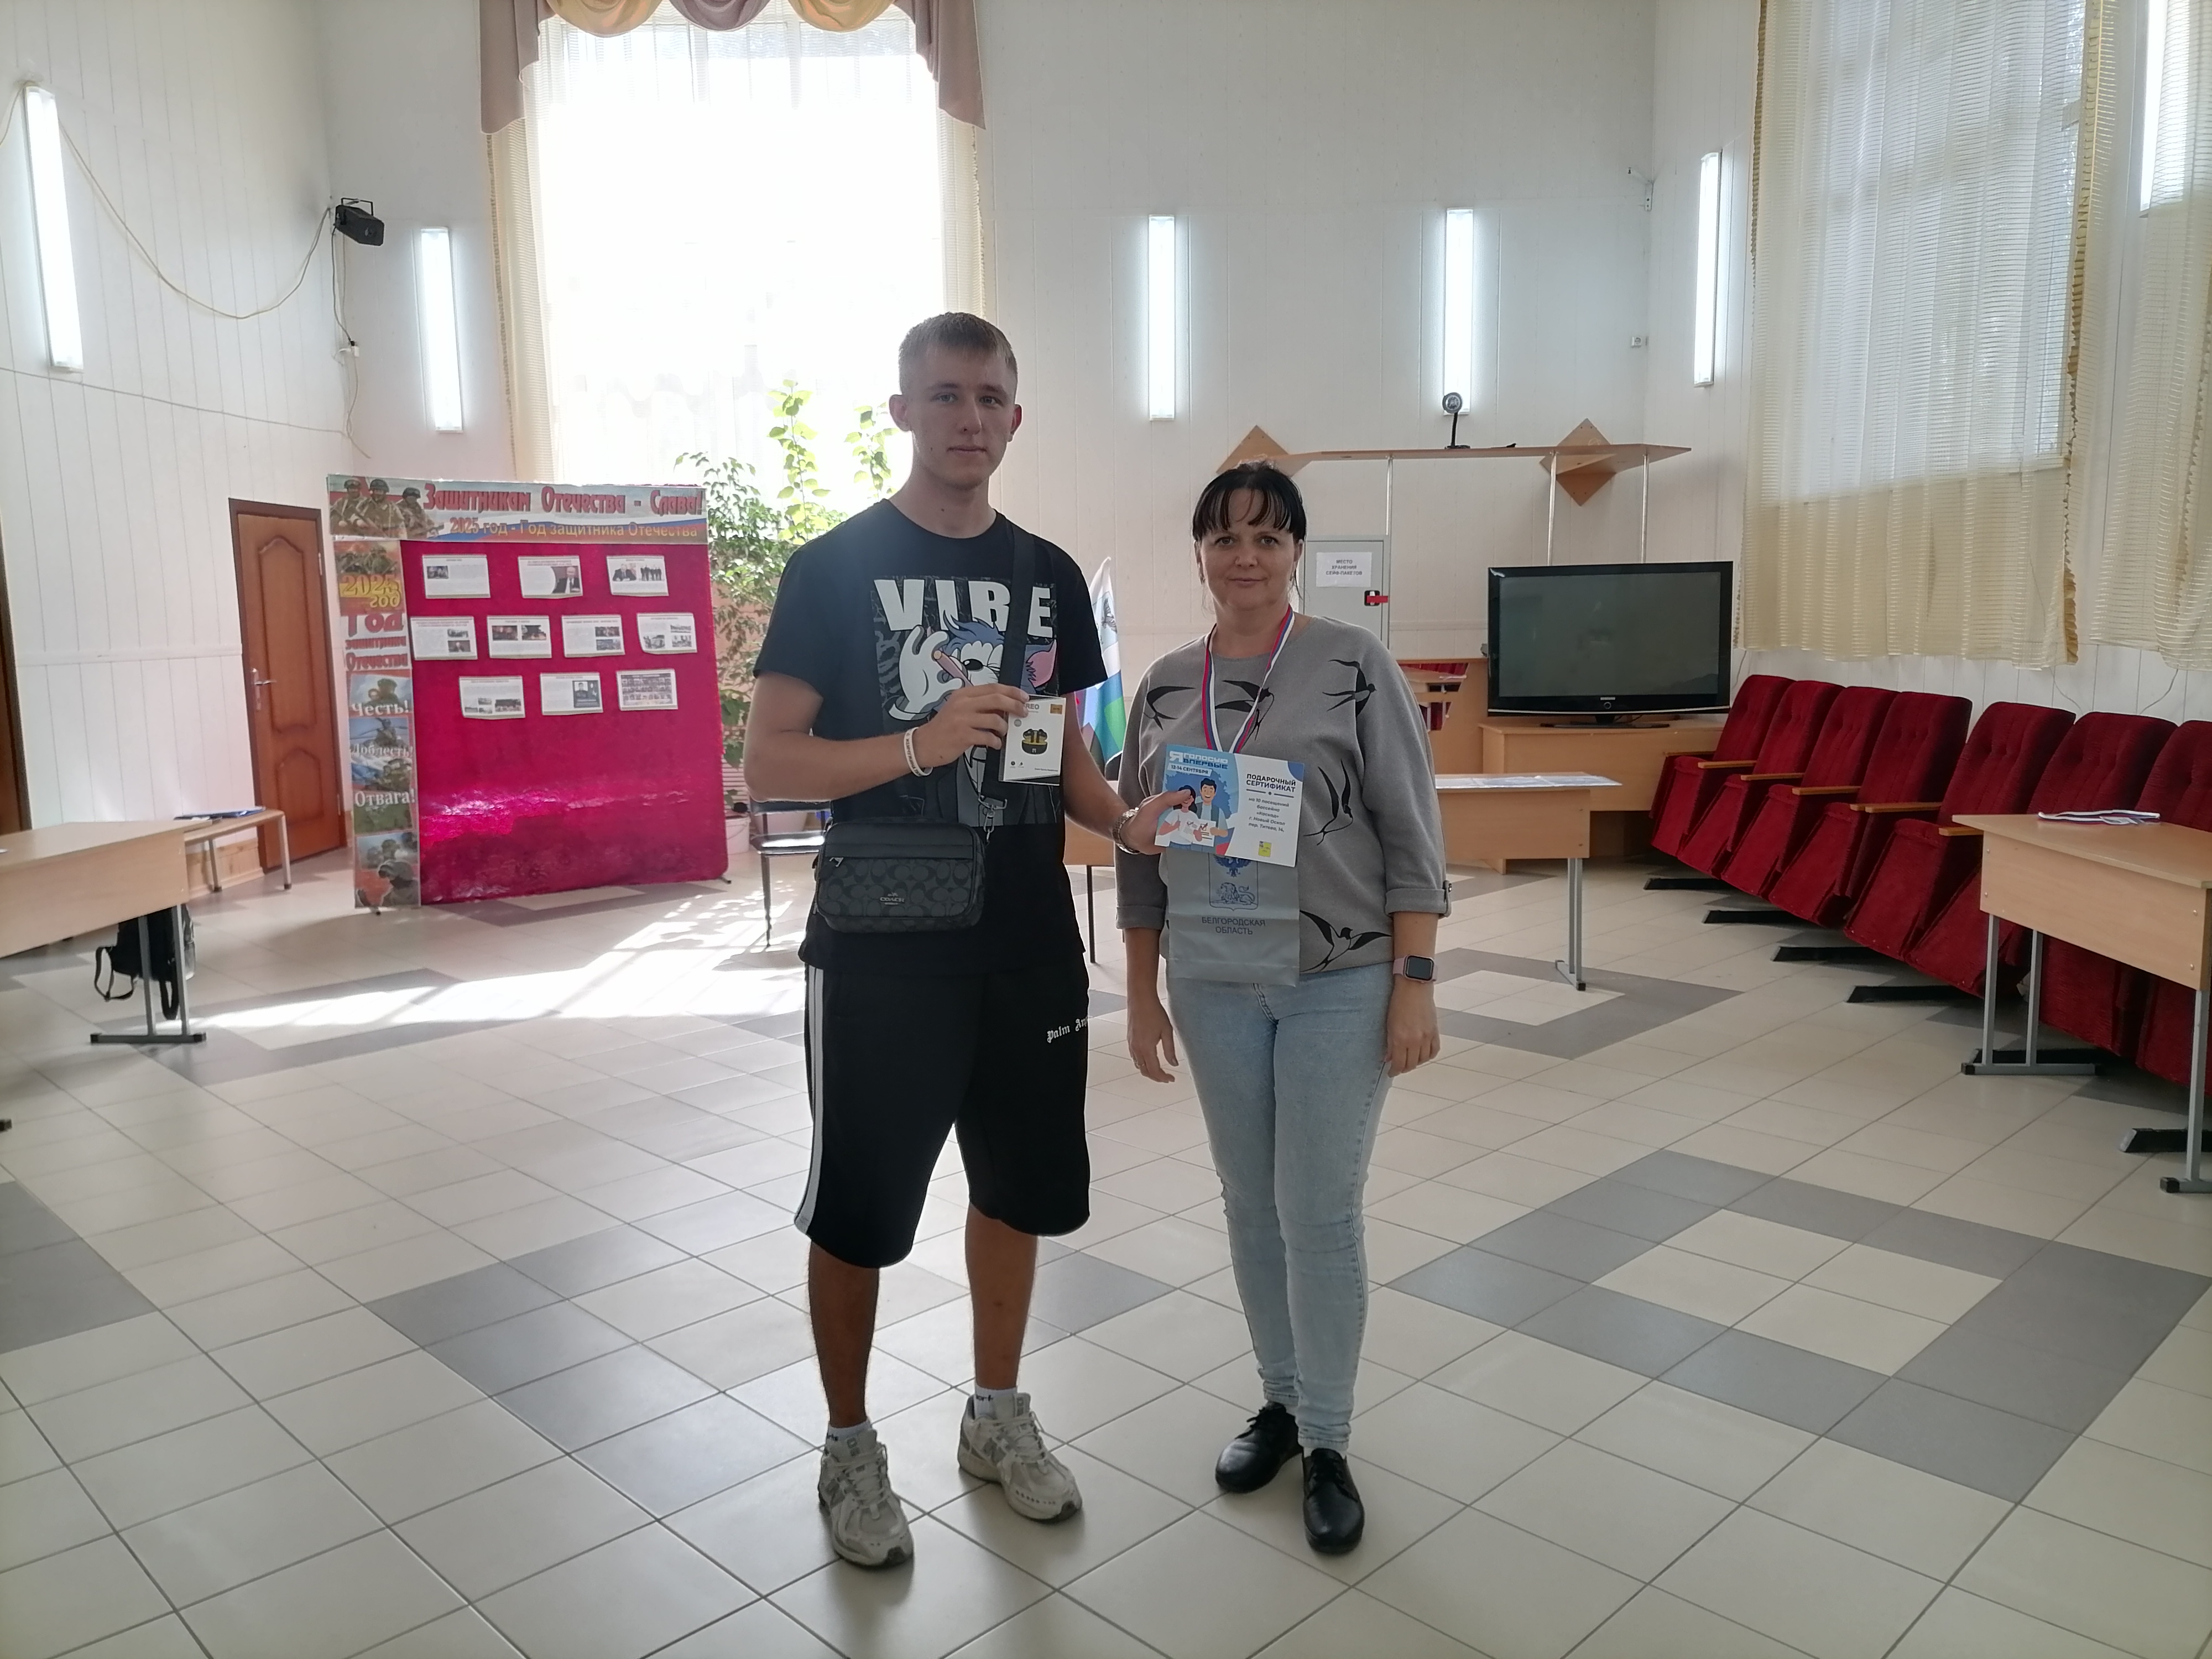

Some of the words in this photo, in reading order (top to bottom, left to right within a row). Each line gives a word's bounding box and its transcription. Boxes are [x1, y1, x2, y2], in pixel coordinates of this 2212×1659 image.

[423, 483, 531, 513] Защитникам
[541, 486, 626, 514] Отечества
[650, 489, 703, 517] Слава!
[450, 517, 479, 534] 2025
[483, 522, 508, 536] год
[520, 519, 547, 537] Год
[550, 524, 625, 536] защитника
[628, 521, 698, 537] Отечества
[342, 574, 399, 596] 2025
[370, 590, 401, 608] год
[874, 578, 1053, 639] VIBE
[347, 613, 404, 638] Год
[346, 652, 409, 672] Отечества
[351, 700, 409, 717] Честь!
[350, 744, 413, 758] Доблесть!
[1169, 750, 1183, 763] Я
[1183, 753, 1228, 764] ГОЛОСУЮ
[1183, 758, 1228, 769] ВПЕРВЫЕ
[1183, 766, 1209, 774] СЕНТЯБРЯ
[1246, 774, 1296, 786] ПОДАРОЧНЫЙ
[1246, 780, 1296, 792] СЕРТИФИКАТ
[354, 788, 415, 807] Отвага!
[1202, 916, 1266, 926] БЕЛГОРОДСКАЯ
[1215, 926, 1253, 935] ОБЛАСТЬ
[1047, 1025, 1071, 1044] Palm
